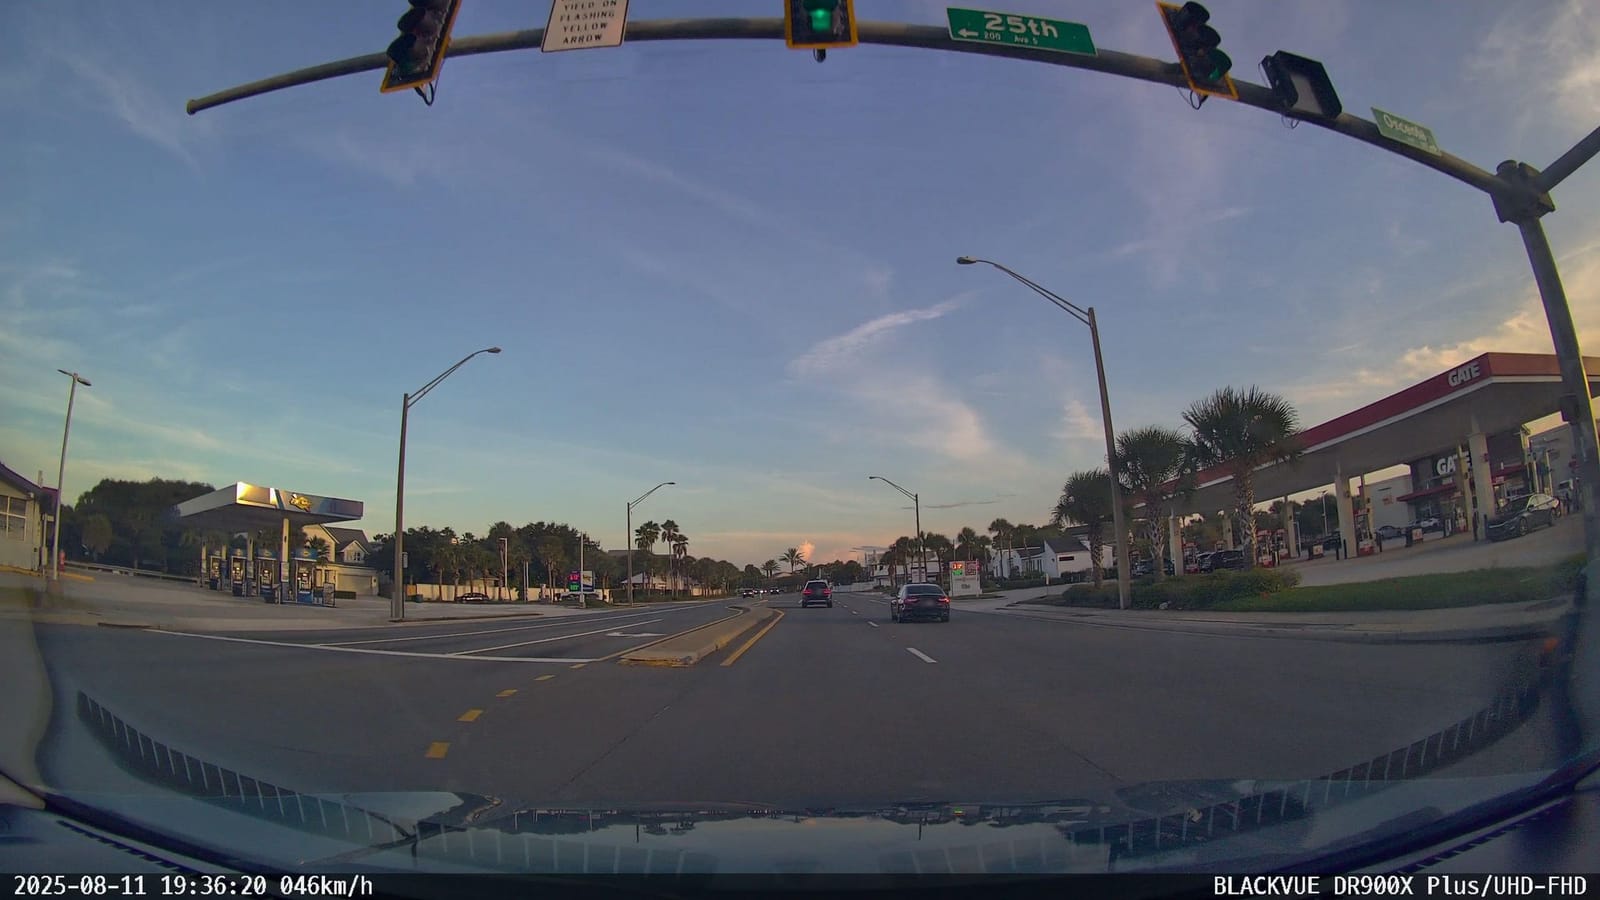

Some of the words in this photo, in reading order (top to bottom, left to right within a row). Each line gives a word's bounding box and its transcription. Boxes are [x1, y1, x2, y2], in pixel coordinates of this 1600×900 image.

[564, 2, 595, 11] YIELD
[560, 11, 615, 22] FLASHING
[563, 22, 608, 33] YELLOW
[984, 13, 1058, 39] 25th
[563, 34, 602, 44] ARROW
[1448, 361, 1481, 387] GATE
